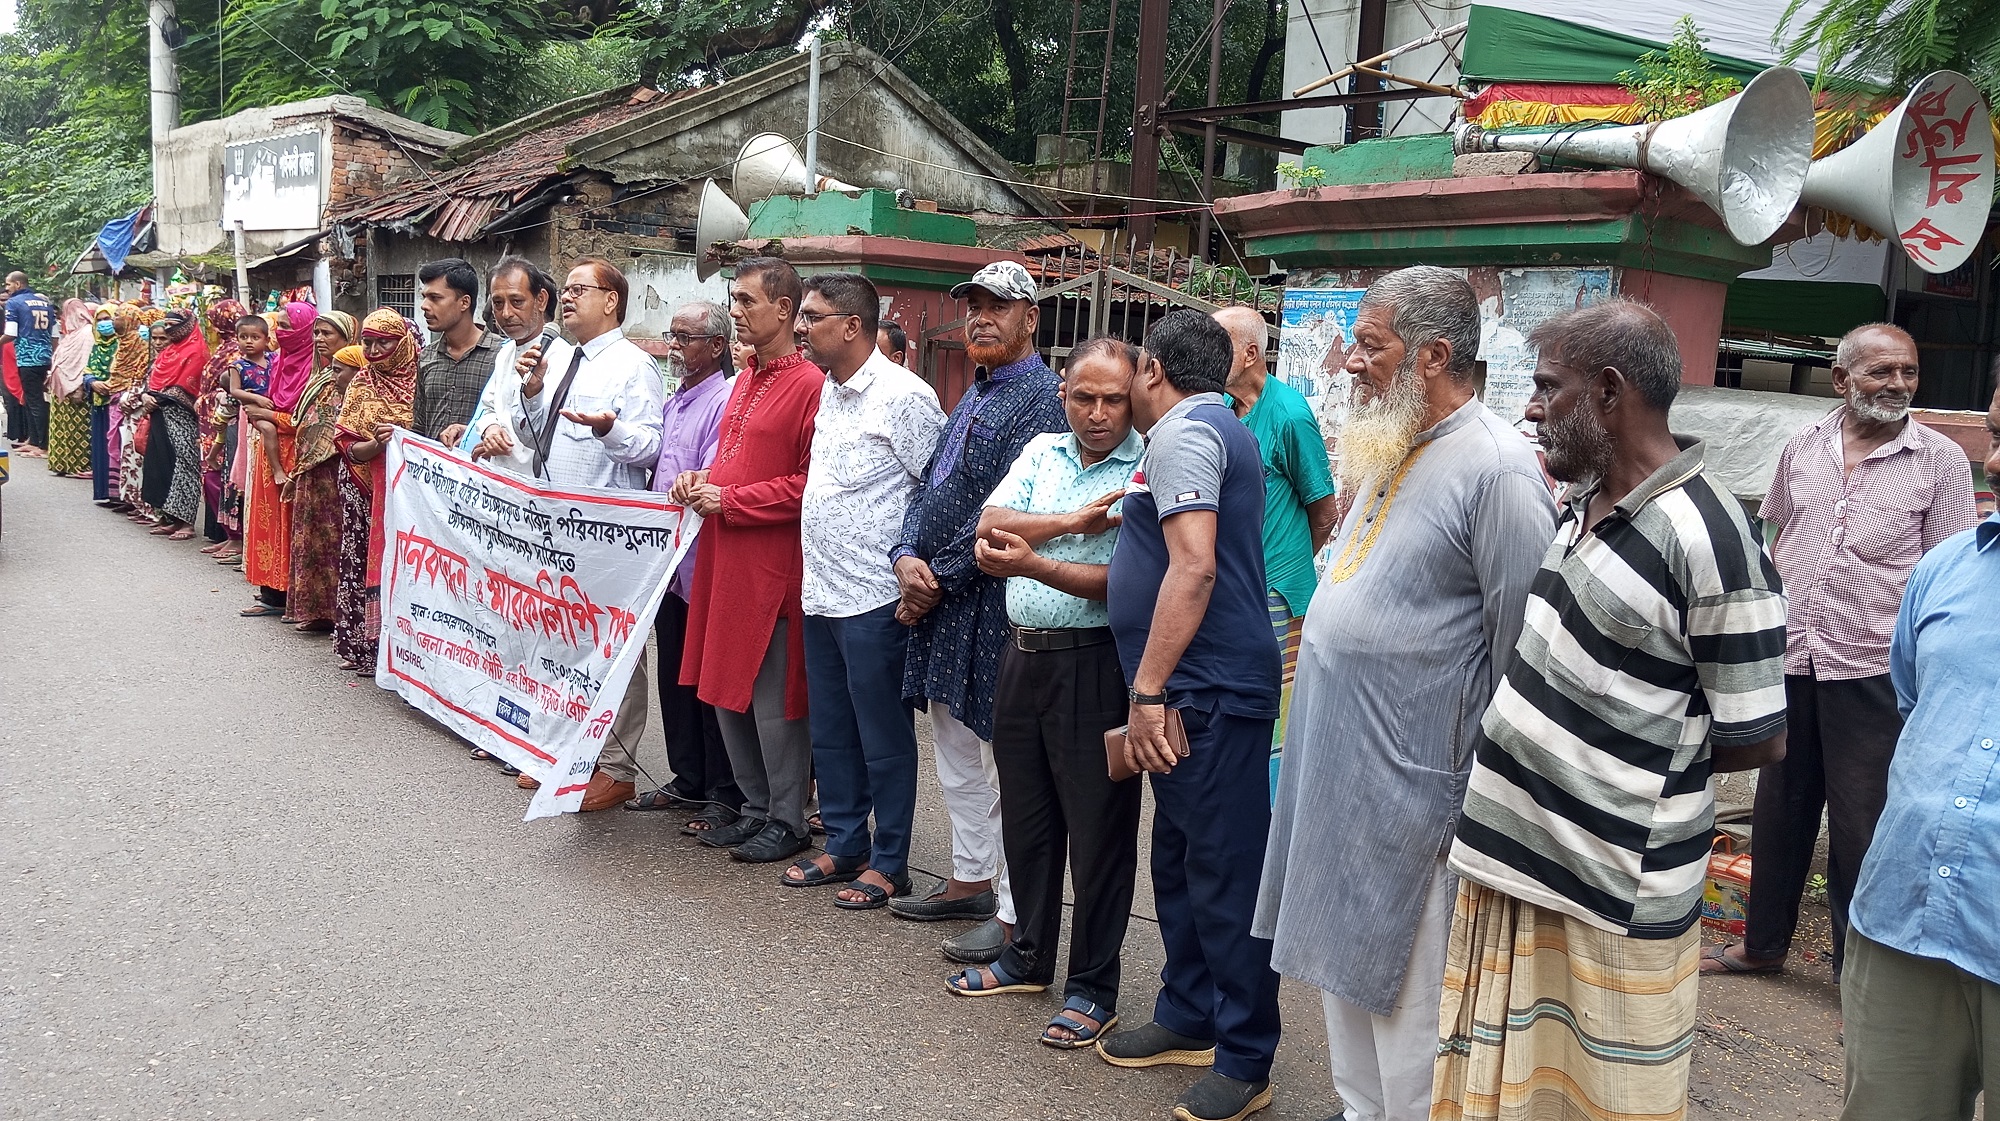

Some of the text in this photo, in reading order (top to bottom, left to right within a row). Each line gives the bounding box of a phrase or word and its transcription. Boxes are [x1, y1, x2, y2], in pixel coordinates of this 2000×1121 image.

[31, 310, 49, 330] 75
[531, 535, 576, 573] দাবিতে
[557, 507, 672, 554] পরিবারগুলোর
[484, 567, 606, 651] স্মারকলিপি
[416, 631, 444, 656] জেলা
[444, 640, 480, 670] নাগরিক
[481, 650, 504, 680] কমিটি
